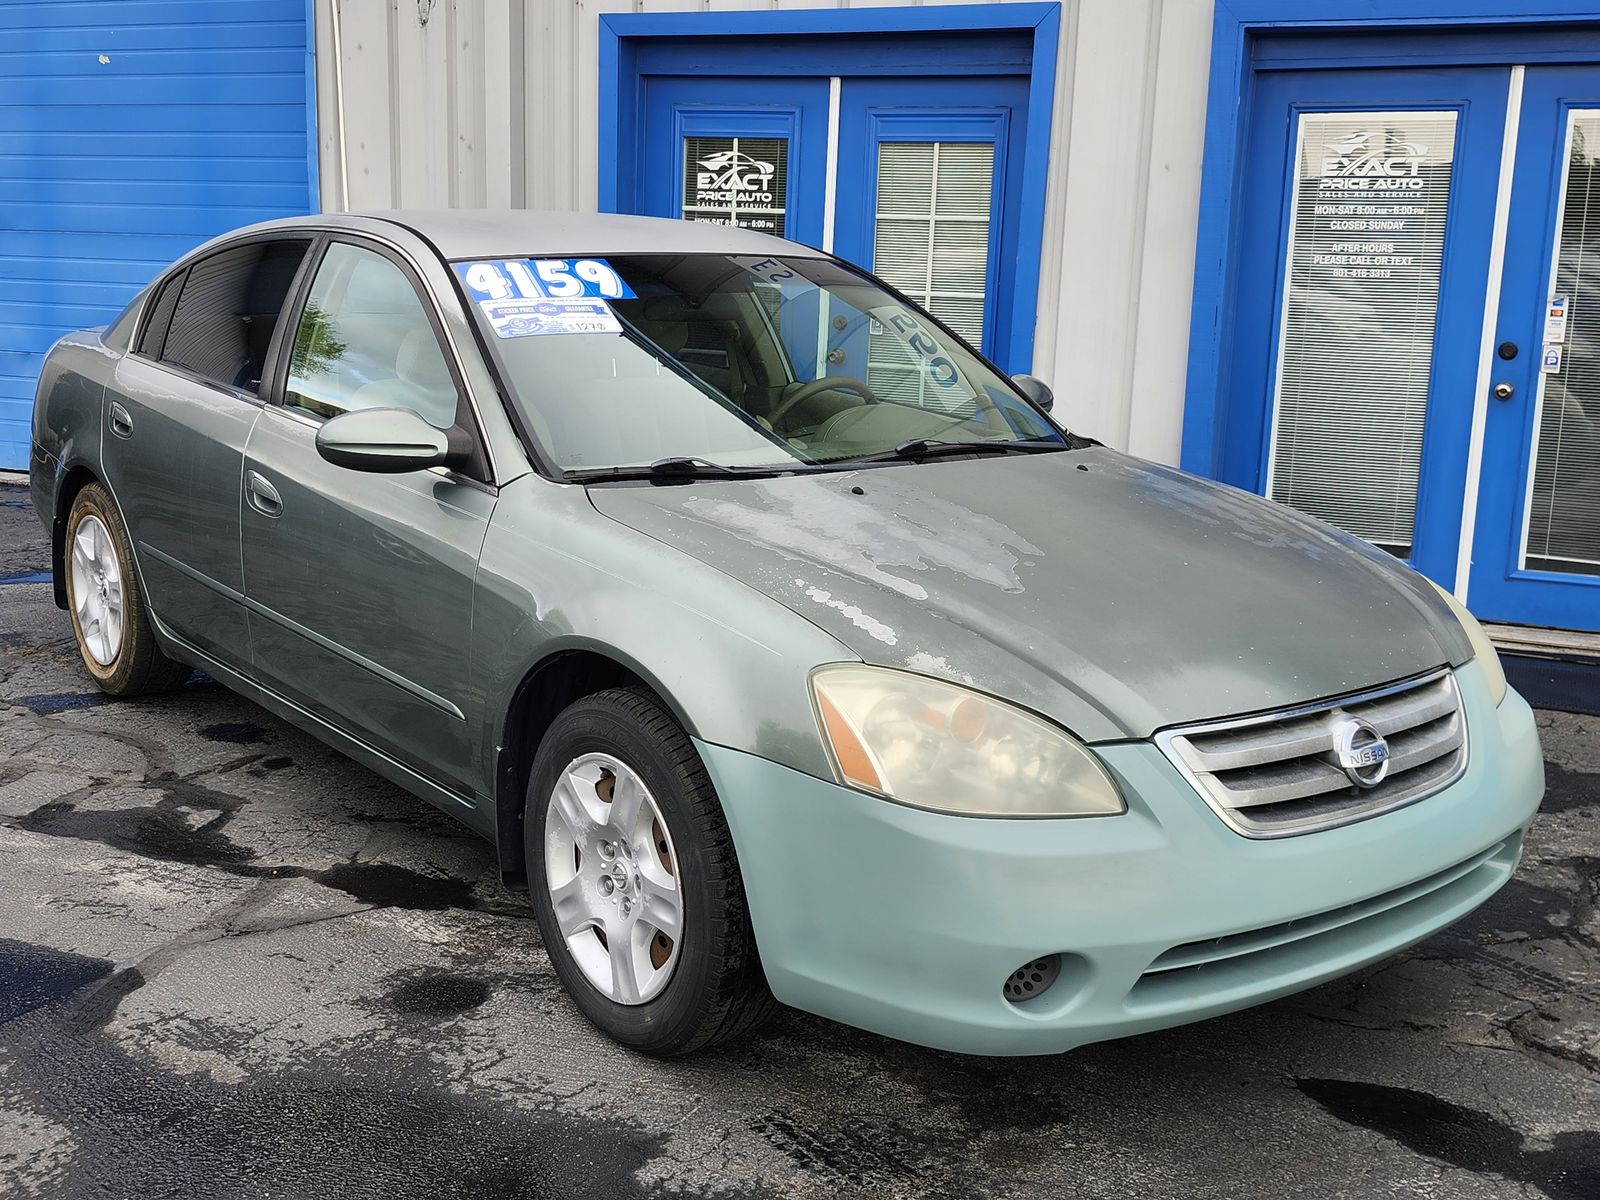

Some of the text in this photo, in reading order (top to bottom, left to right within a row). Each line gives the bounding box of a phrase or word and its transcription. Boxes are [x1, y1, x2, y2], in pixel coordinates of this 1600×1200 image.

[1321, 157, 1427, 177] EXACT
[697, 172, 774, 190] EXACT
[1319, 178, 1425, 189] PRICE AUTO
[697, 191, 773, 203] PRICE AUTO
[697, 201, 719, 209] SALES
[1393, 206, 1413, 215] 6:00
[751, 220, 766, 228] 6:00
[1330, 220, 1405, 230] CLOSED SUNDAY
[1331, 243, 1395, 253] AFTER HOURS
[1313, 255, 1414, 265] PLEASE CALL OR TEXT
[465, 259, 624, 300] 4159
[1350, 747, 1389, 765] NISSAN
